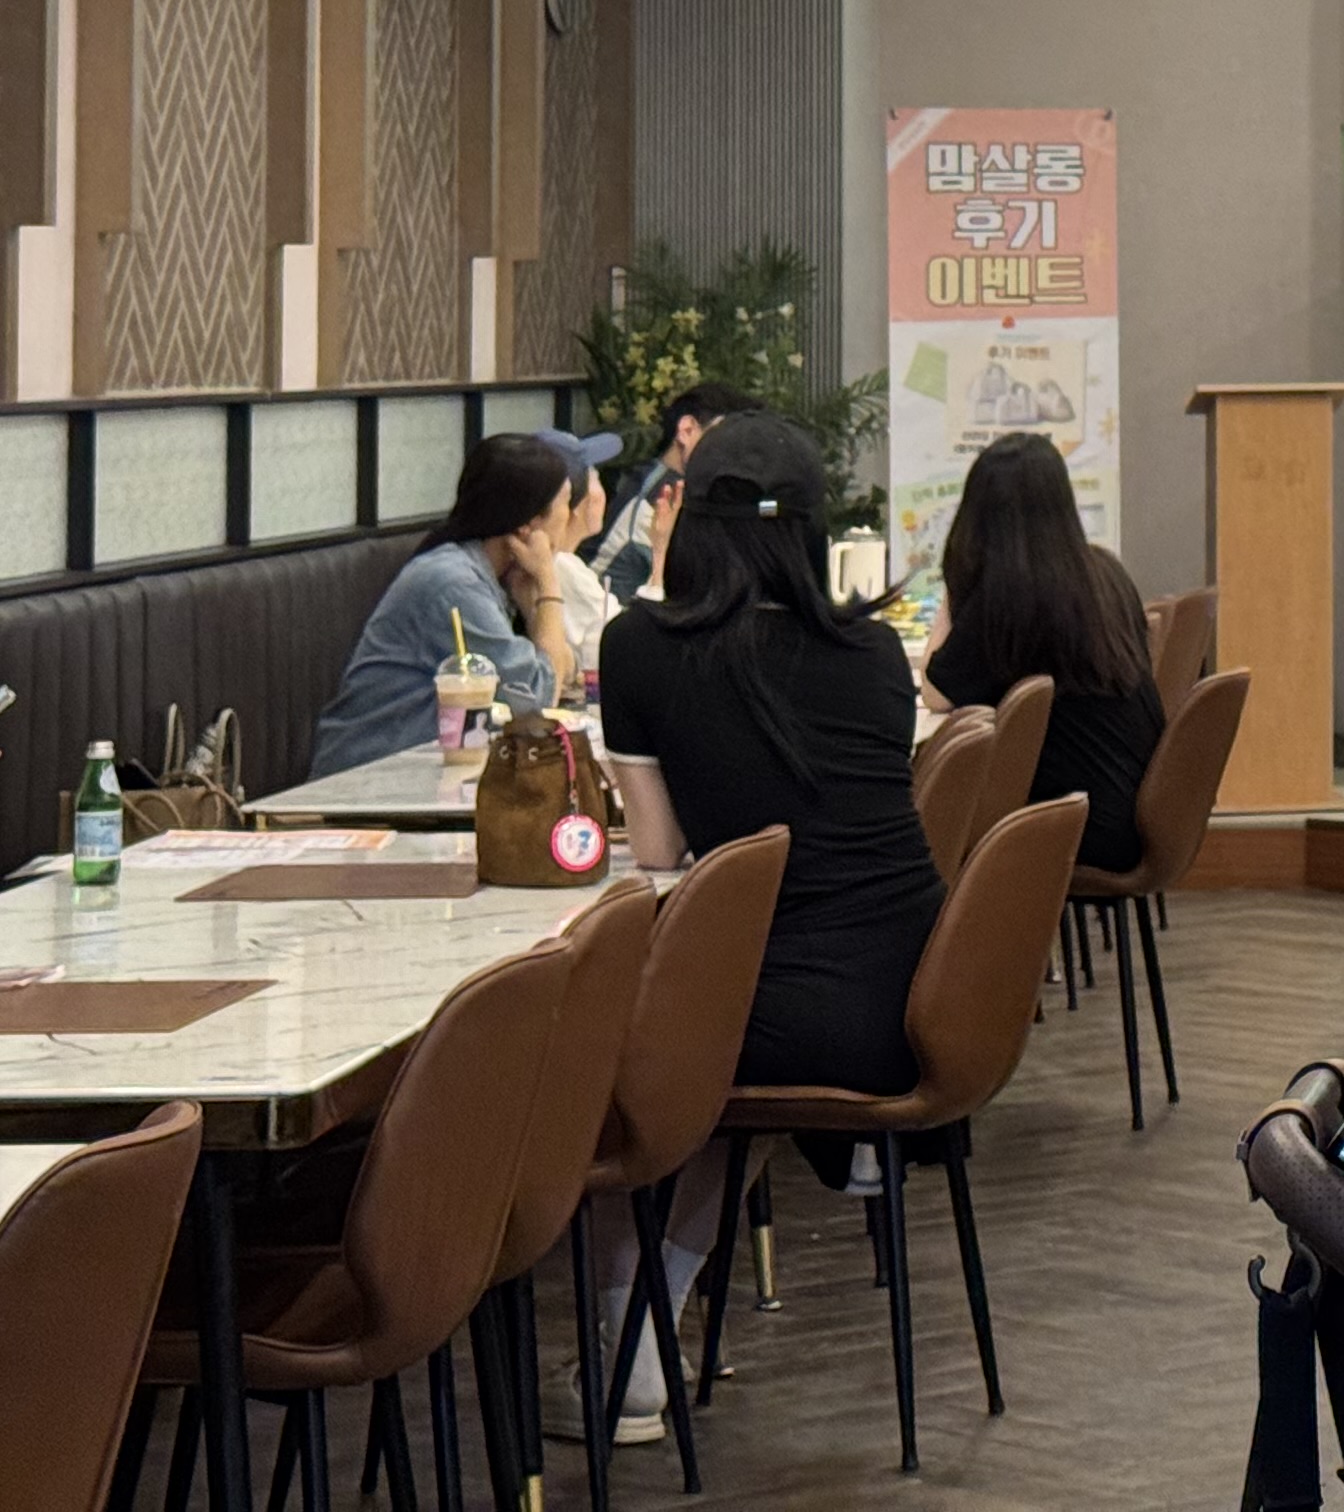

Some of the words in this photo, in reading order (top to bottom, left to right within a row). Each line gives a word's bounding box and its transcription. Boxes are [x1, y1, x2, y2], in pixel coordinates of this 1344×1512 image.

[925, 142, 1085, 194] 맘살롱
[952, 198, 1059, 251] 후기
[926, 255, 1088, 307] 이벤트
